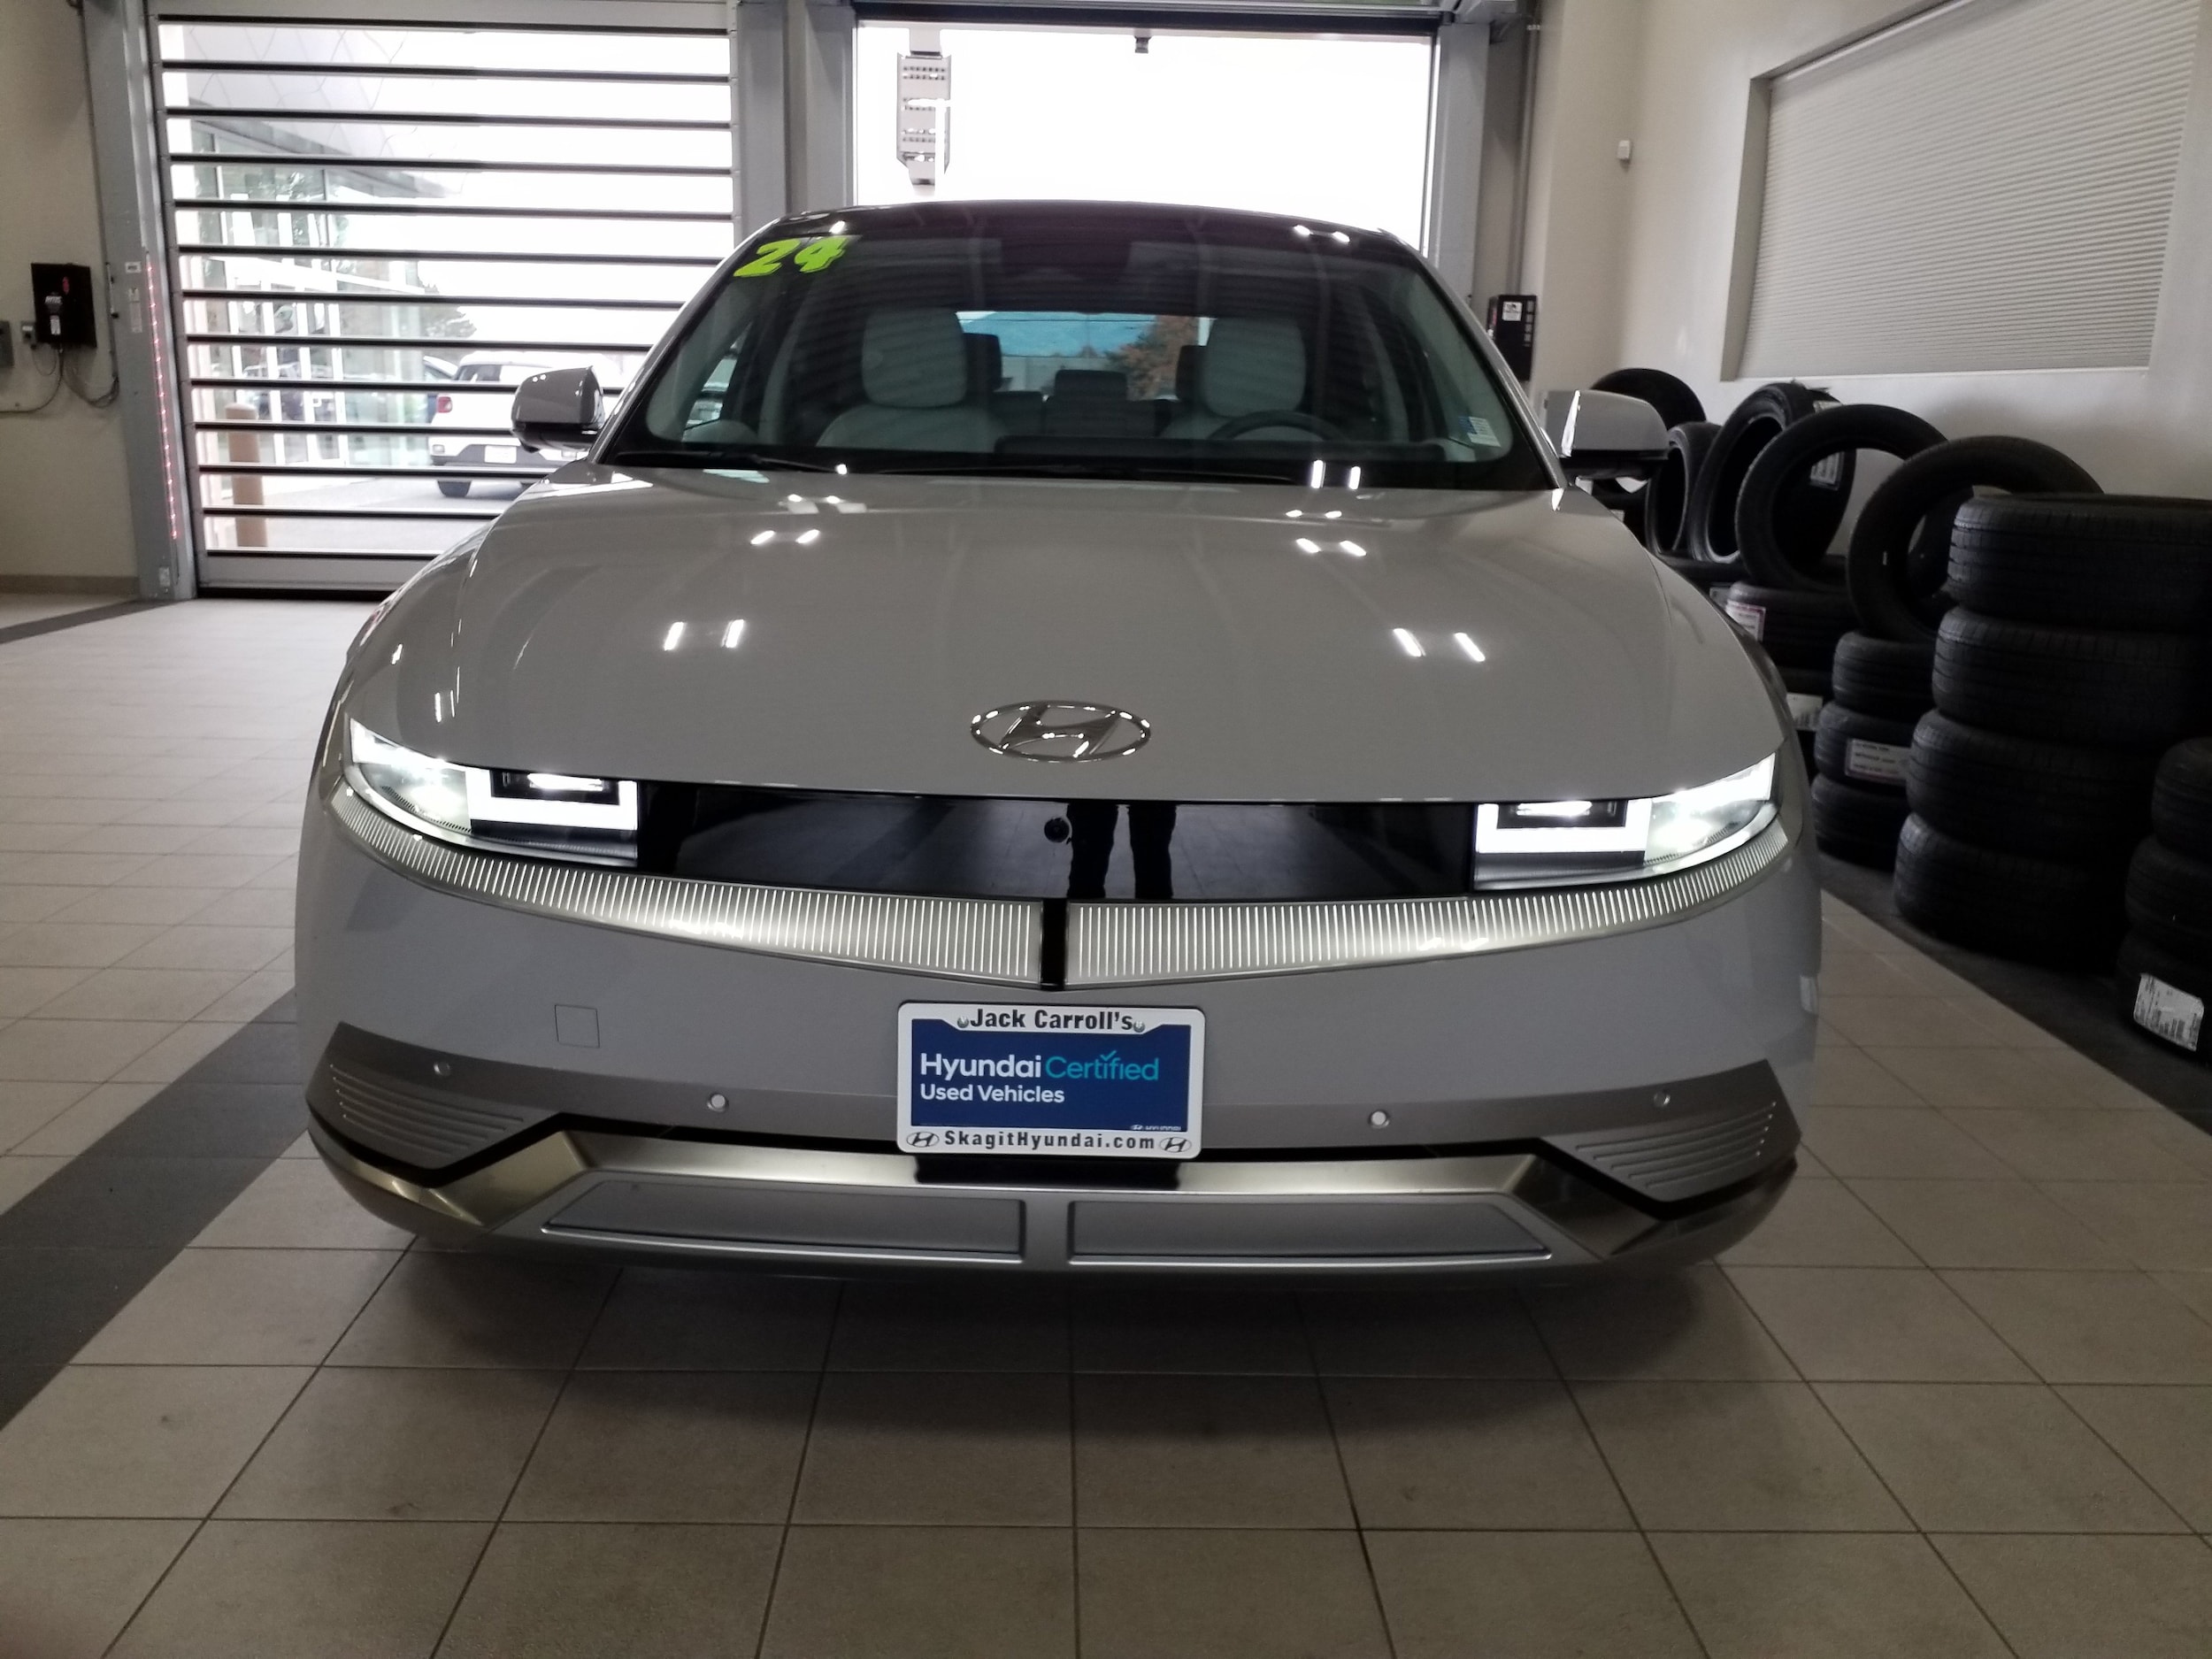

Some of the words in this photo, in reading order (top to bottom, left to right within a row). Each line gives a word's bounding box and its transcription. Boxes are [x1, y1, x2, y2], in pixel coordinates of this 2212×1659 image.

[733, 235, 848, 277] 24
[971, 1009, 1026, 1028] Jack
[1034, 1010, 1133, 1031] Carroll's
[920, 1053, 1042, 1080] Hyundai
[1046, 1050, 1160, 1081] Certified
[920, 1084, 973, 1102] Used
[978, 1085, 1065, 1103] Vehicles
[944, 1130, 1156, 1150] SkagitHyundai.com
